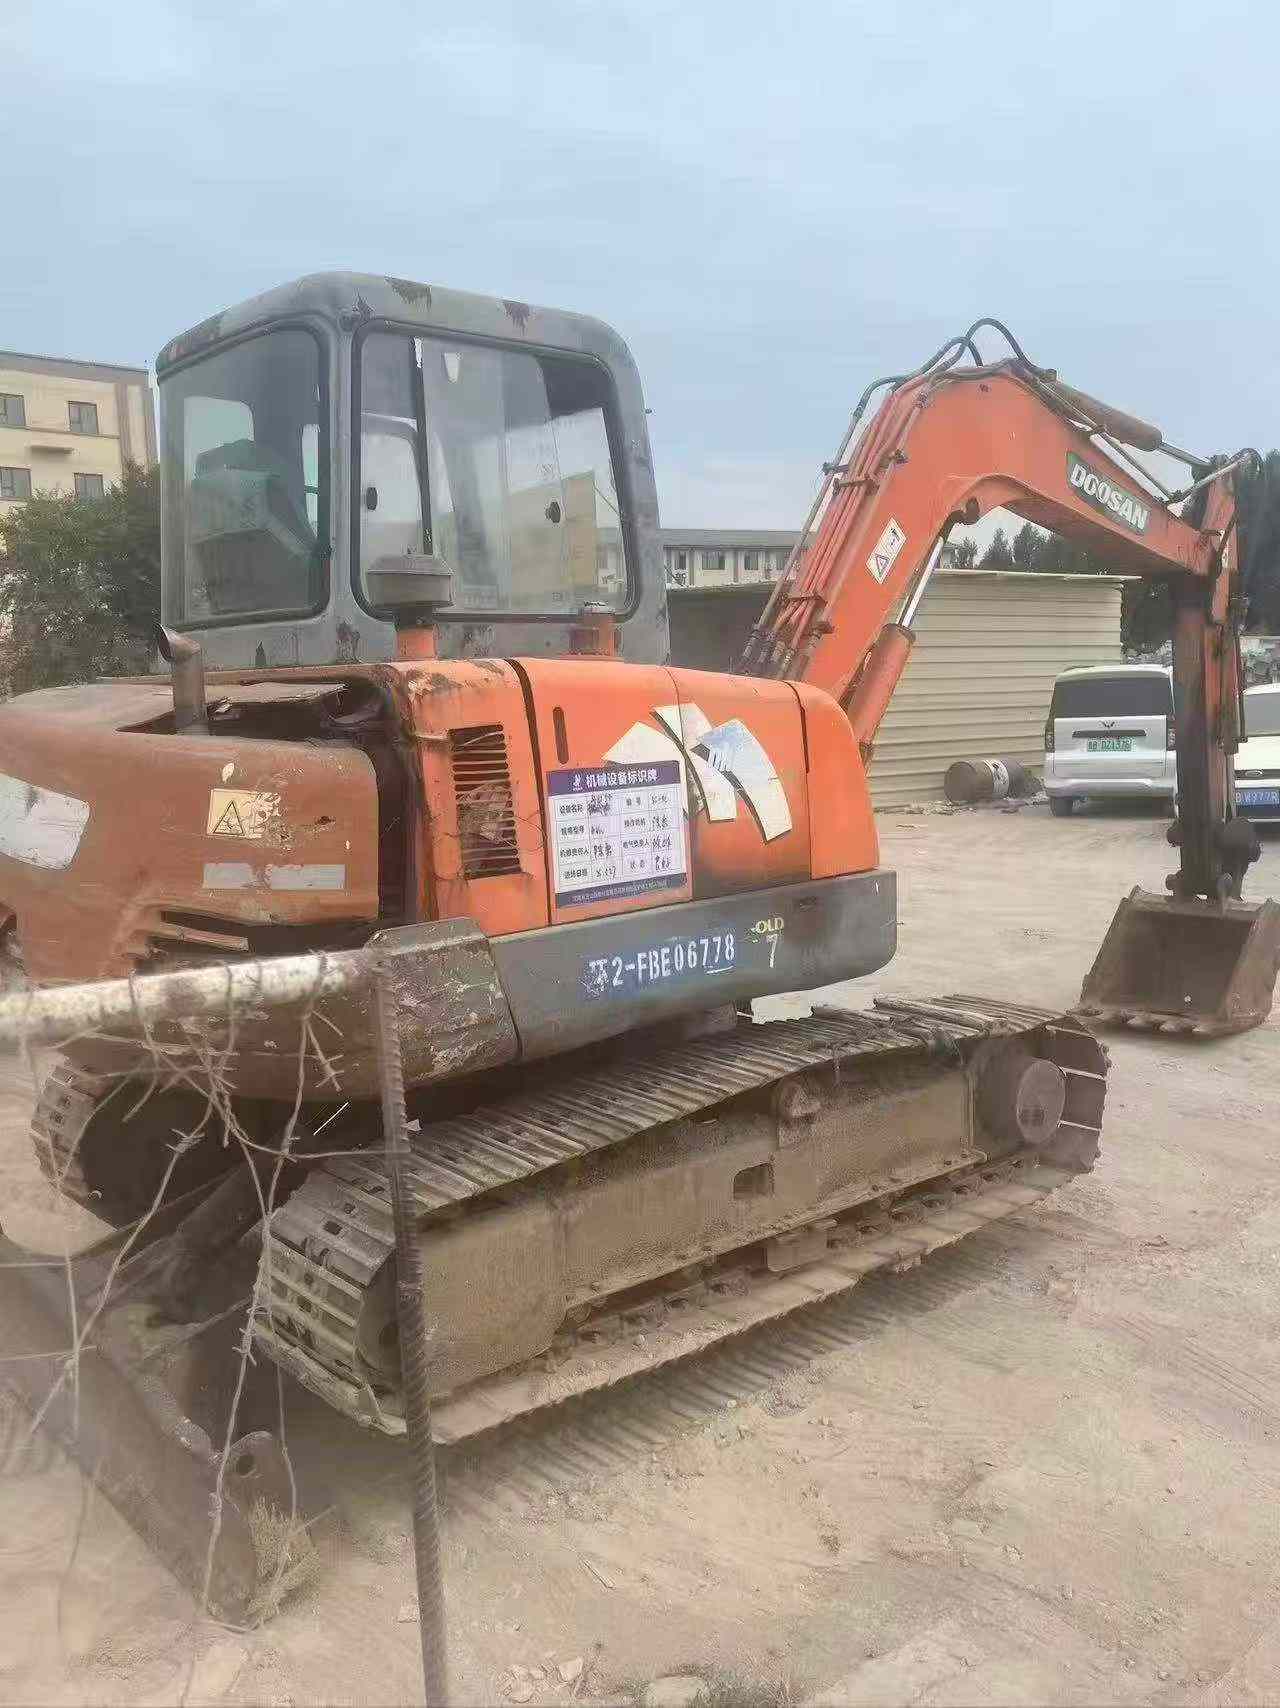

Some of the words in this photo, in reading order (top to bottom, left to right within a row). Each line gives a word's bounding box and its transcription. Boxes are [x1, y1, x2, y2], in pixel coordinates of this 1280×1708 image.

[1070, 464, 1148, 530] DOOSAN
[586, 768, 659, 788] 机械设备标识牌
